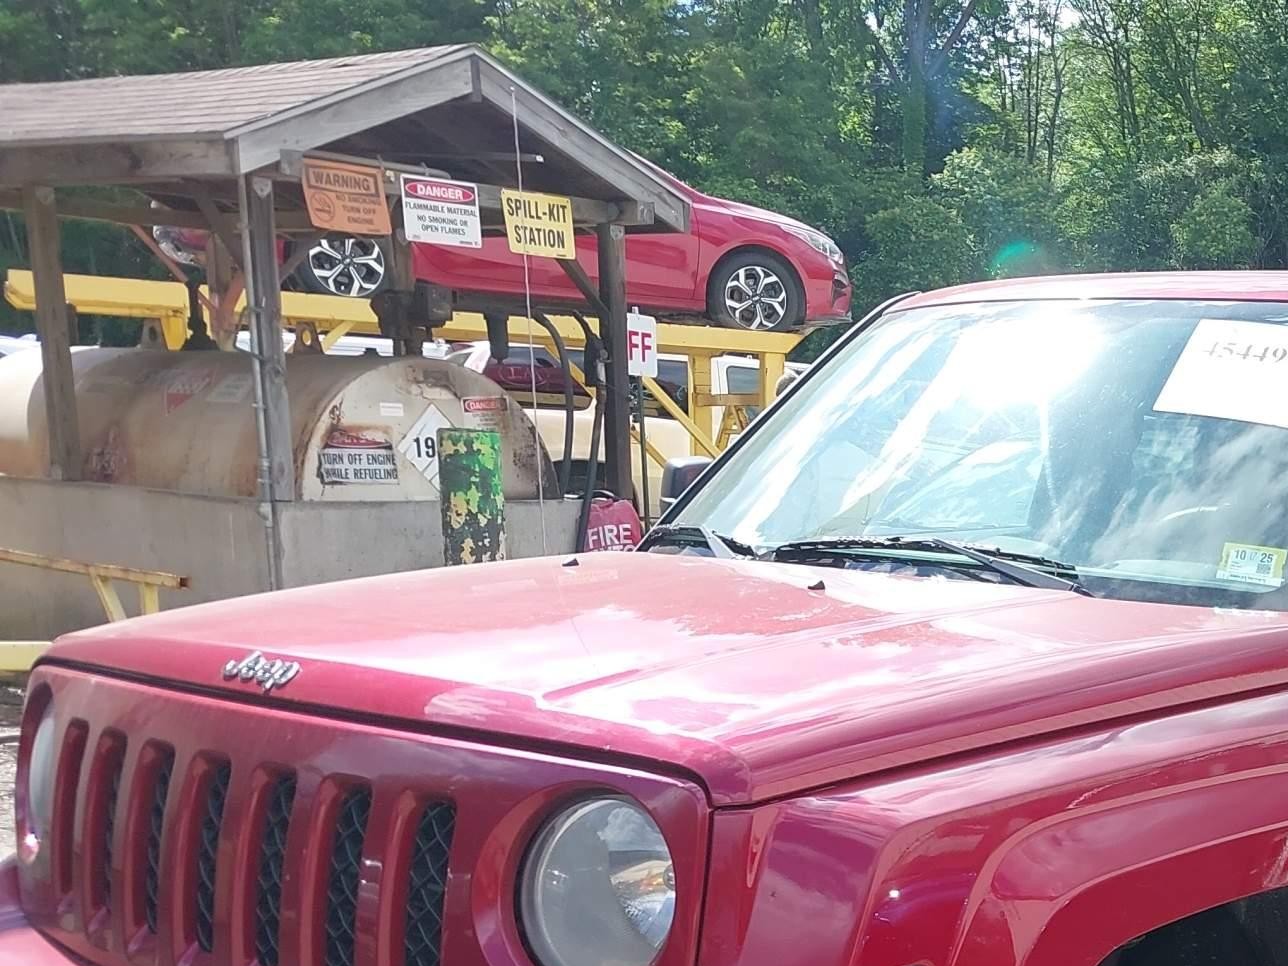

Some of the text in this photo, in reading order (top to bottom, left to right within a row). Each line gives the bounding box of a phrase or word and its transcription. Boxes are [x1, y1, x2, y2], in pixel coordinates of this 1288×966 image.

[312, 170, 370, 192] WARNING
[416, 183, 464, 200] DANGER
[405, 201, 478, 217] FLAMMABLE MATERIAL
[506, 197, 567, 223] SPILL-KIT
[417, 214, 426, 222] NO
[428, 215, 458, 226] SMOKING
[421, 223, 466, 236] OPEN FLAMES
[514, 224, 565, 249] STATION
[322, 453, 397, 466] TURN OFF ENGINE
[324, 467, 398, 480] WHILE REFUELING
[587, 523, 633, 549] FIRE
[1260, 552, 1274, 564] 25
[223, 650, 301, 692] Jeep
